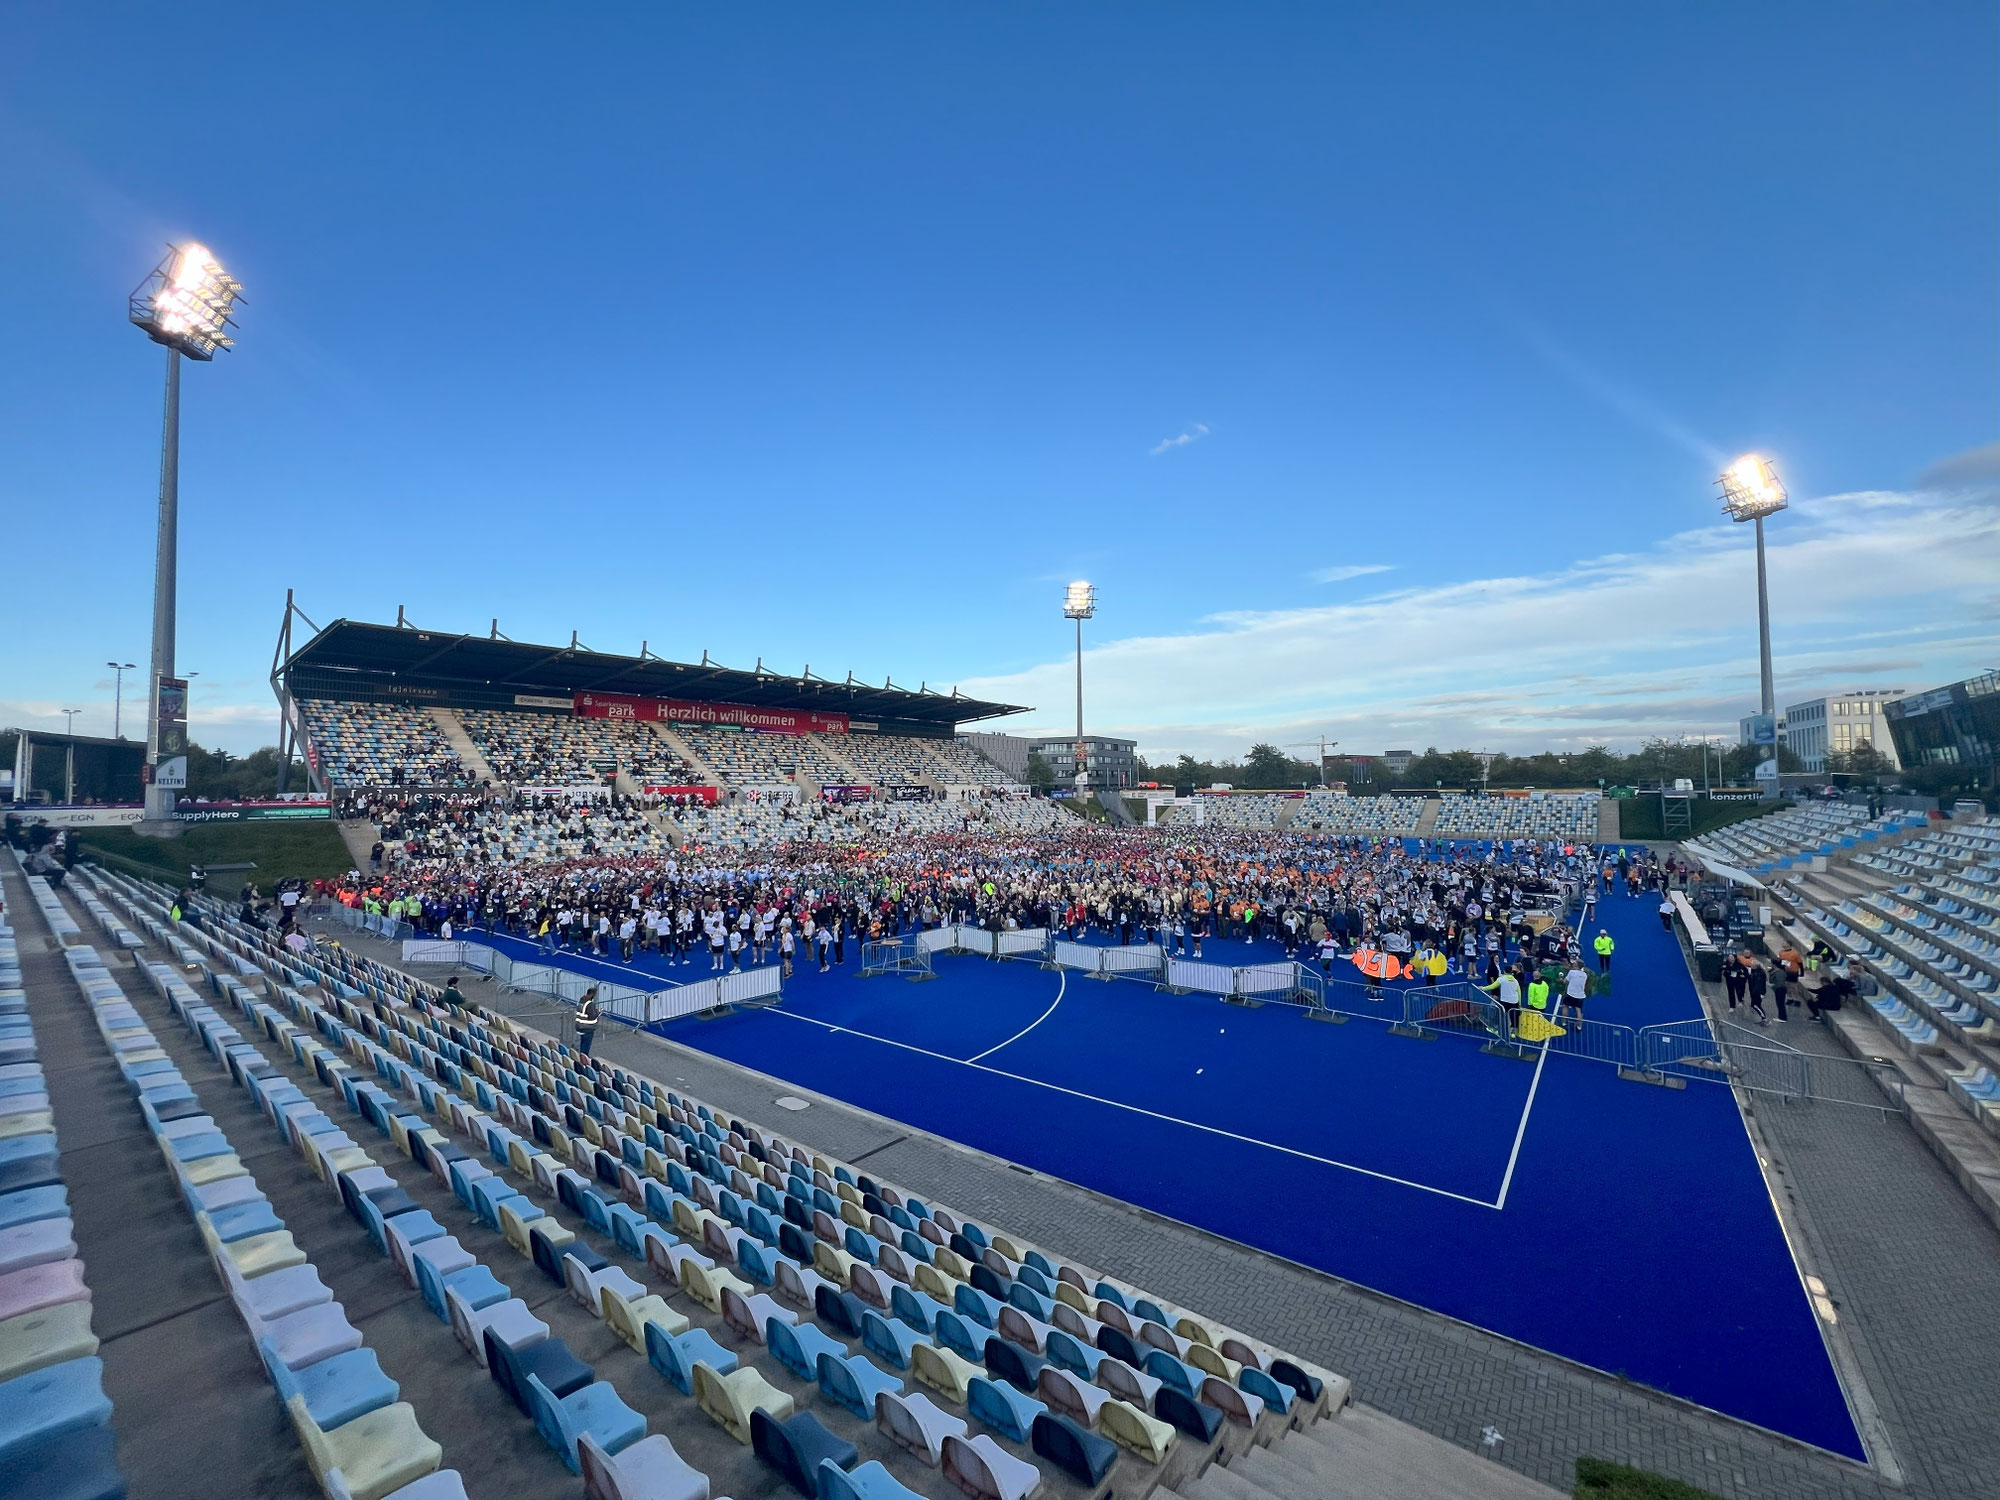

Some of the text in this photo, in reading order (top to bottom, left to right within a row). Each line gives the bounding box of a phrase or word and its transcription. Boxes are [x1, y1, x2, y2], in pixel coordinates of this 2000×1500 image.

[609, 704, 635, 717] park
[657, 704, 796, 726] Herzlich willkommen
[827, 722, 844, 731] park
[71, 814, 95, 822] EGN
[121, 813, 144, 821] EGN
[172, 810, 239, 821] SupplyHero
